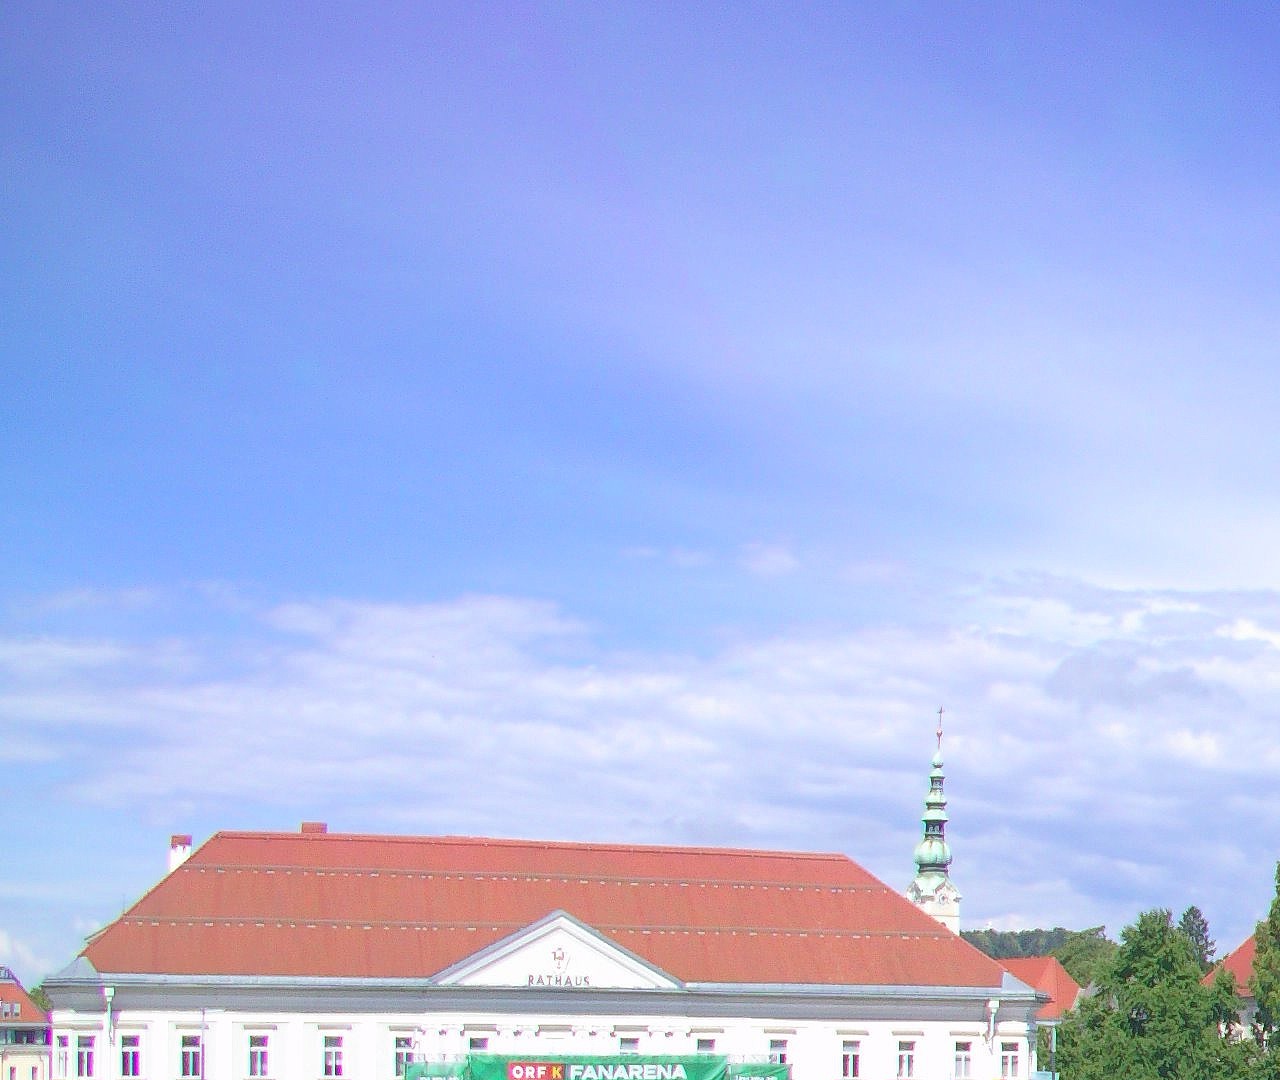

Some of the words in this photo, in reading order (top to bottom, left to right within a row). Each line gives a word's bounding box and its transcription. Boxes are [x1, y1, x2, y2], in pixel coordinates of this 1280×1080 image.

[528, 974, 590, 987] RATHAUS
[512, 1065, 547, 1080] ORF
[551, 1065, 562, 1080] K
[570, 1064, 688, 1080] FANARENA
